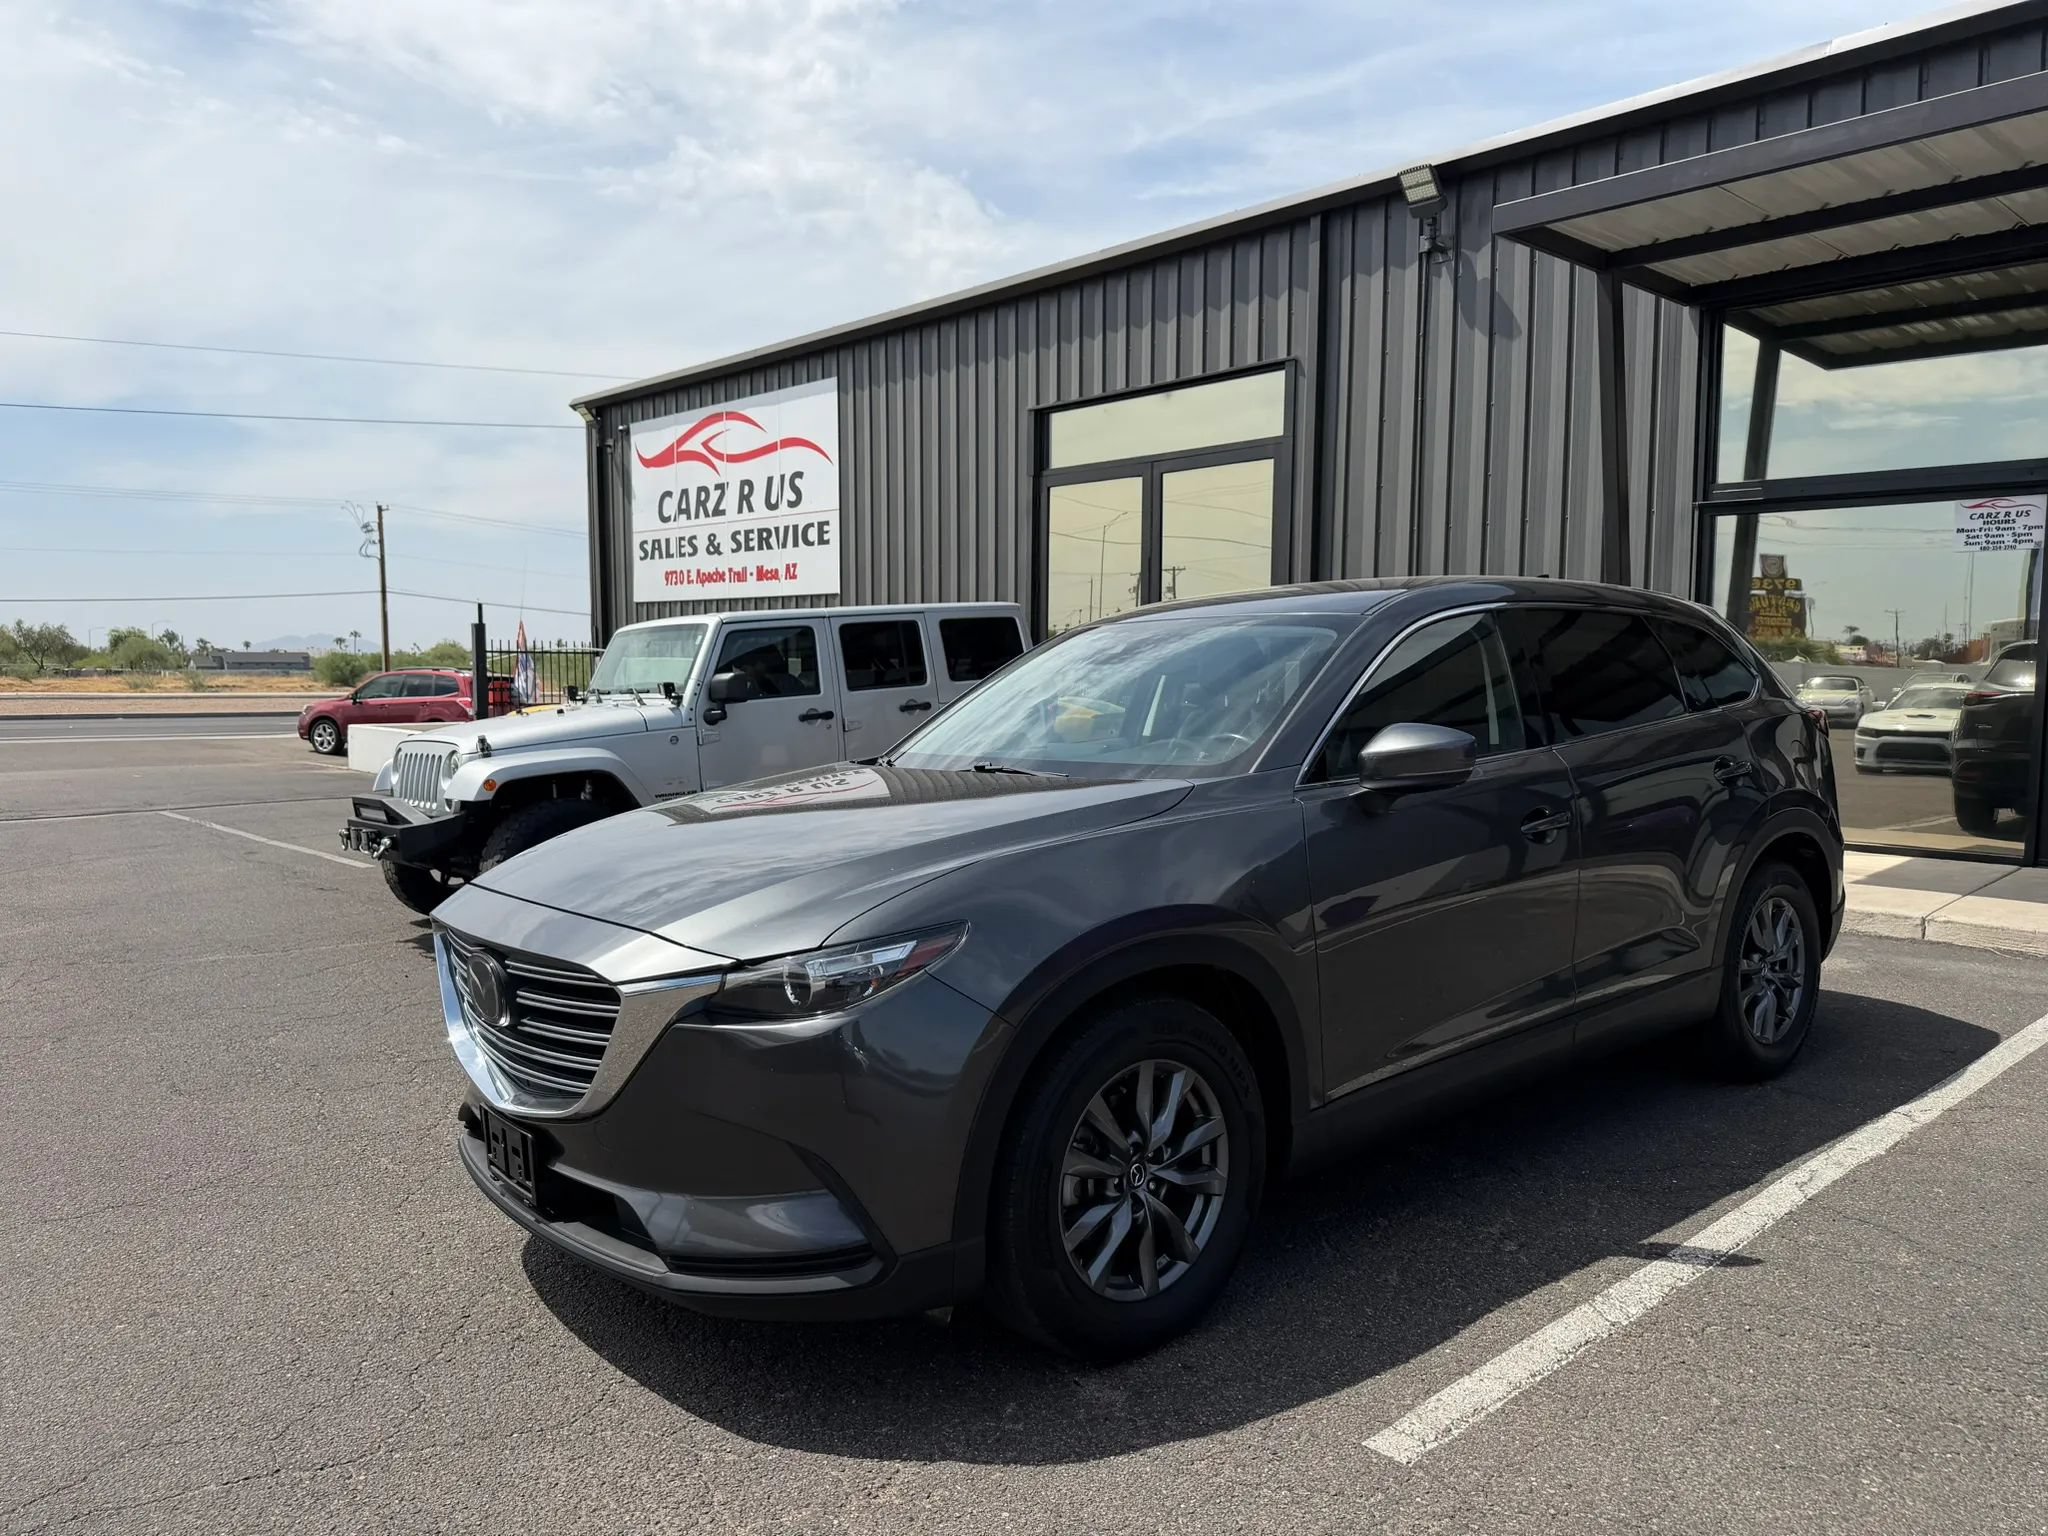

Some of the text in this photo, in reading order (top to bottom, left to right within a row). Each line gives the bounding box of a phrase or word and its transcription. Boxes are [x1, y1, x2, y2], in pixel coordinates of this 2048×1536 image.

[658, 471, 804, 523] CARZ R US
[1969, 512, 2001, 520] CARZ
[639, 520, 830, 561] SALES & SERVICE
[664, 568, 685, 586] 9730
[686, 568, 695, 584] E.
[695, 567, 726, 588] Apache
[728, 566, 748, 583] Trail
[784, 562, 798, 580] AZ
